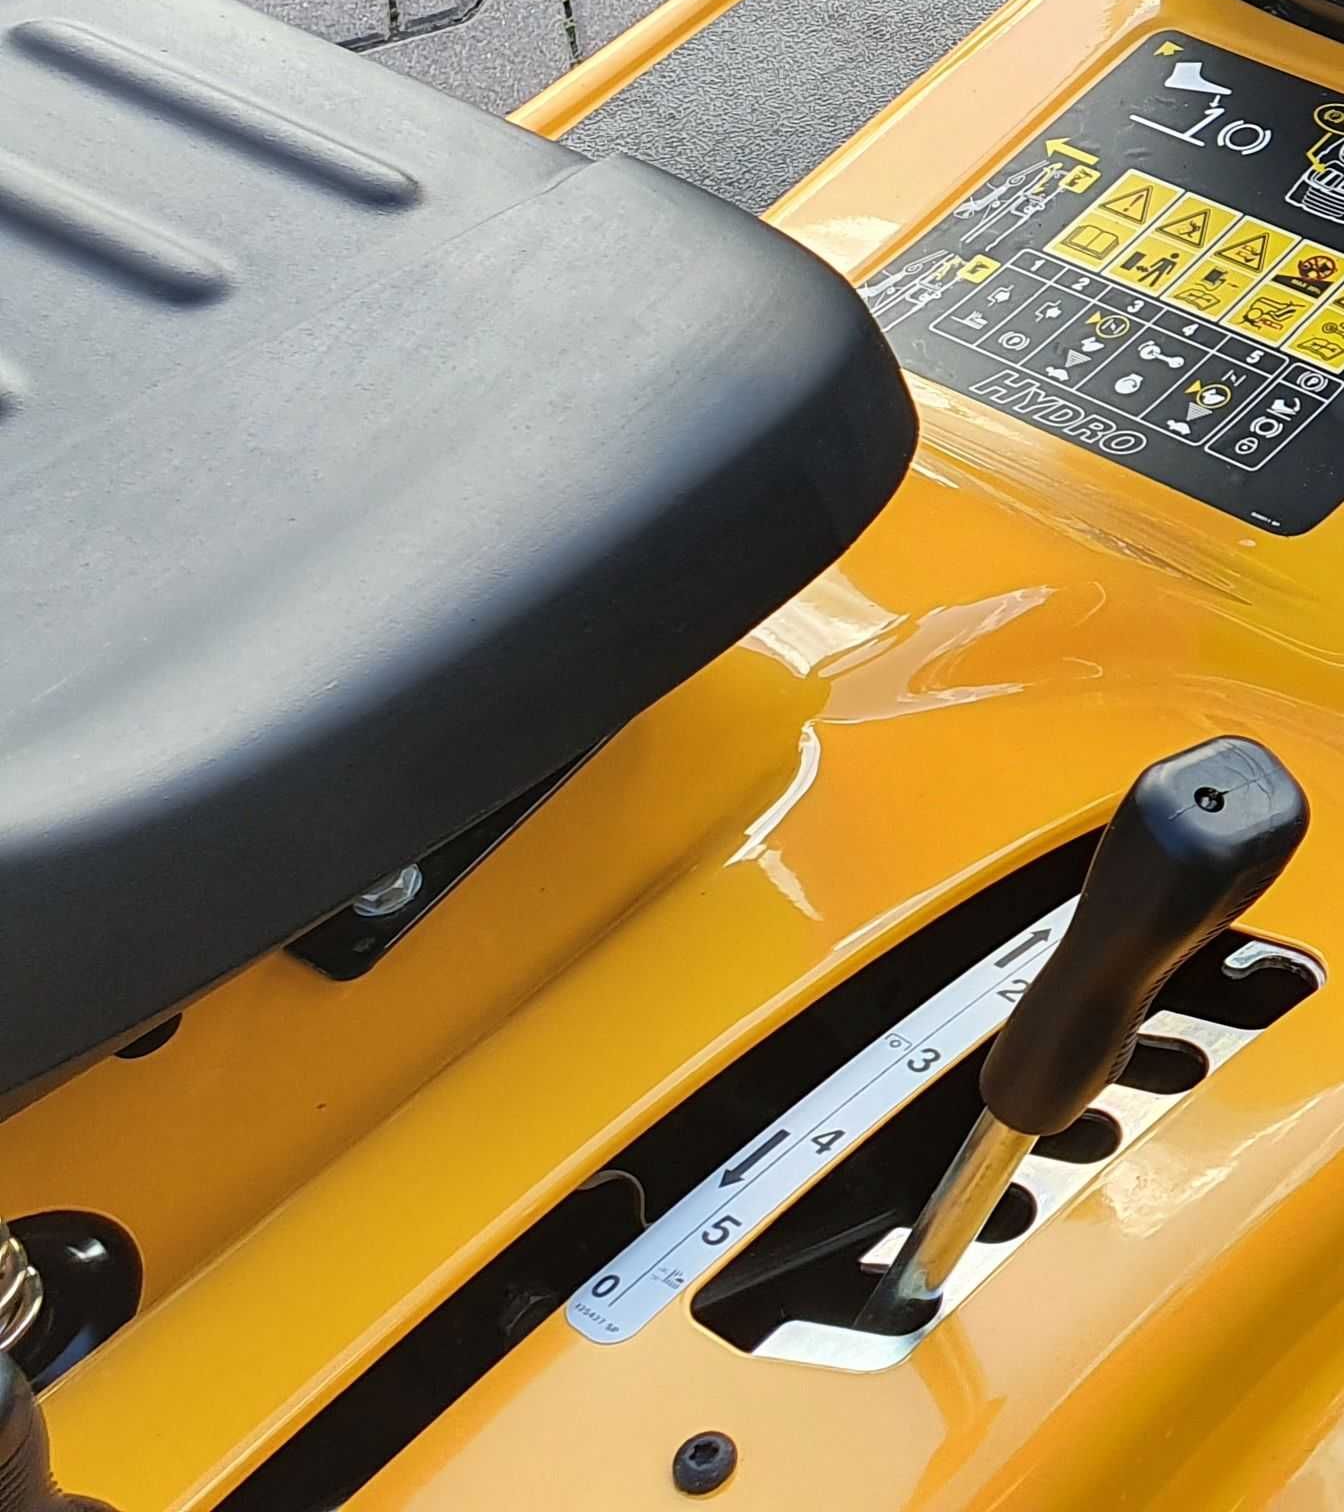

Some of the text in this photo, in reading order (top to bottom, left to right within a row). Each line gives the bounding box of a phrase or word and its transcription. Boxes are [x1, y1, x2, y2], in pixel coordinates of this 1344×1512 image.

[1030, 258, 1264, 364] 1 2 3 4 5
[969, 369, 1147, 454] HYDRO
[907, 1048, 942, 1073] 3
[810, 1129, 845, 1155] 4
[702, 1214, 743, 1246] 5
